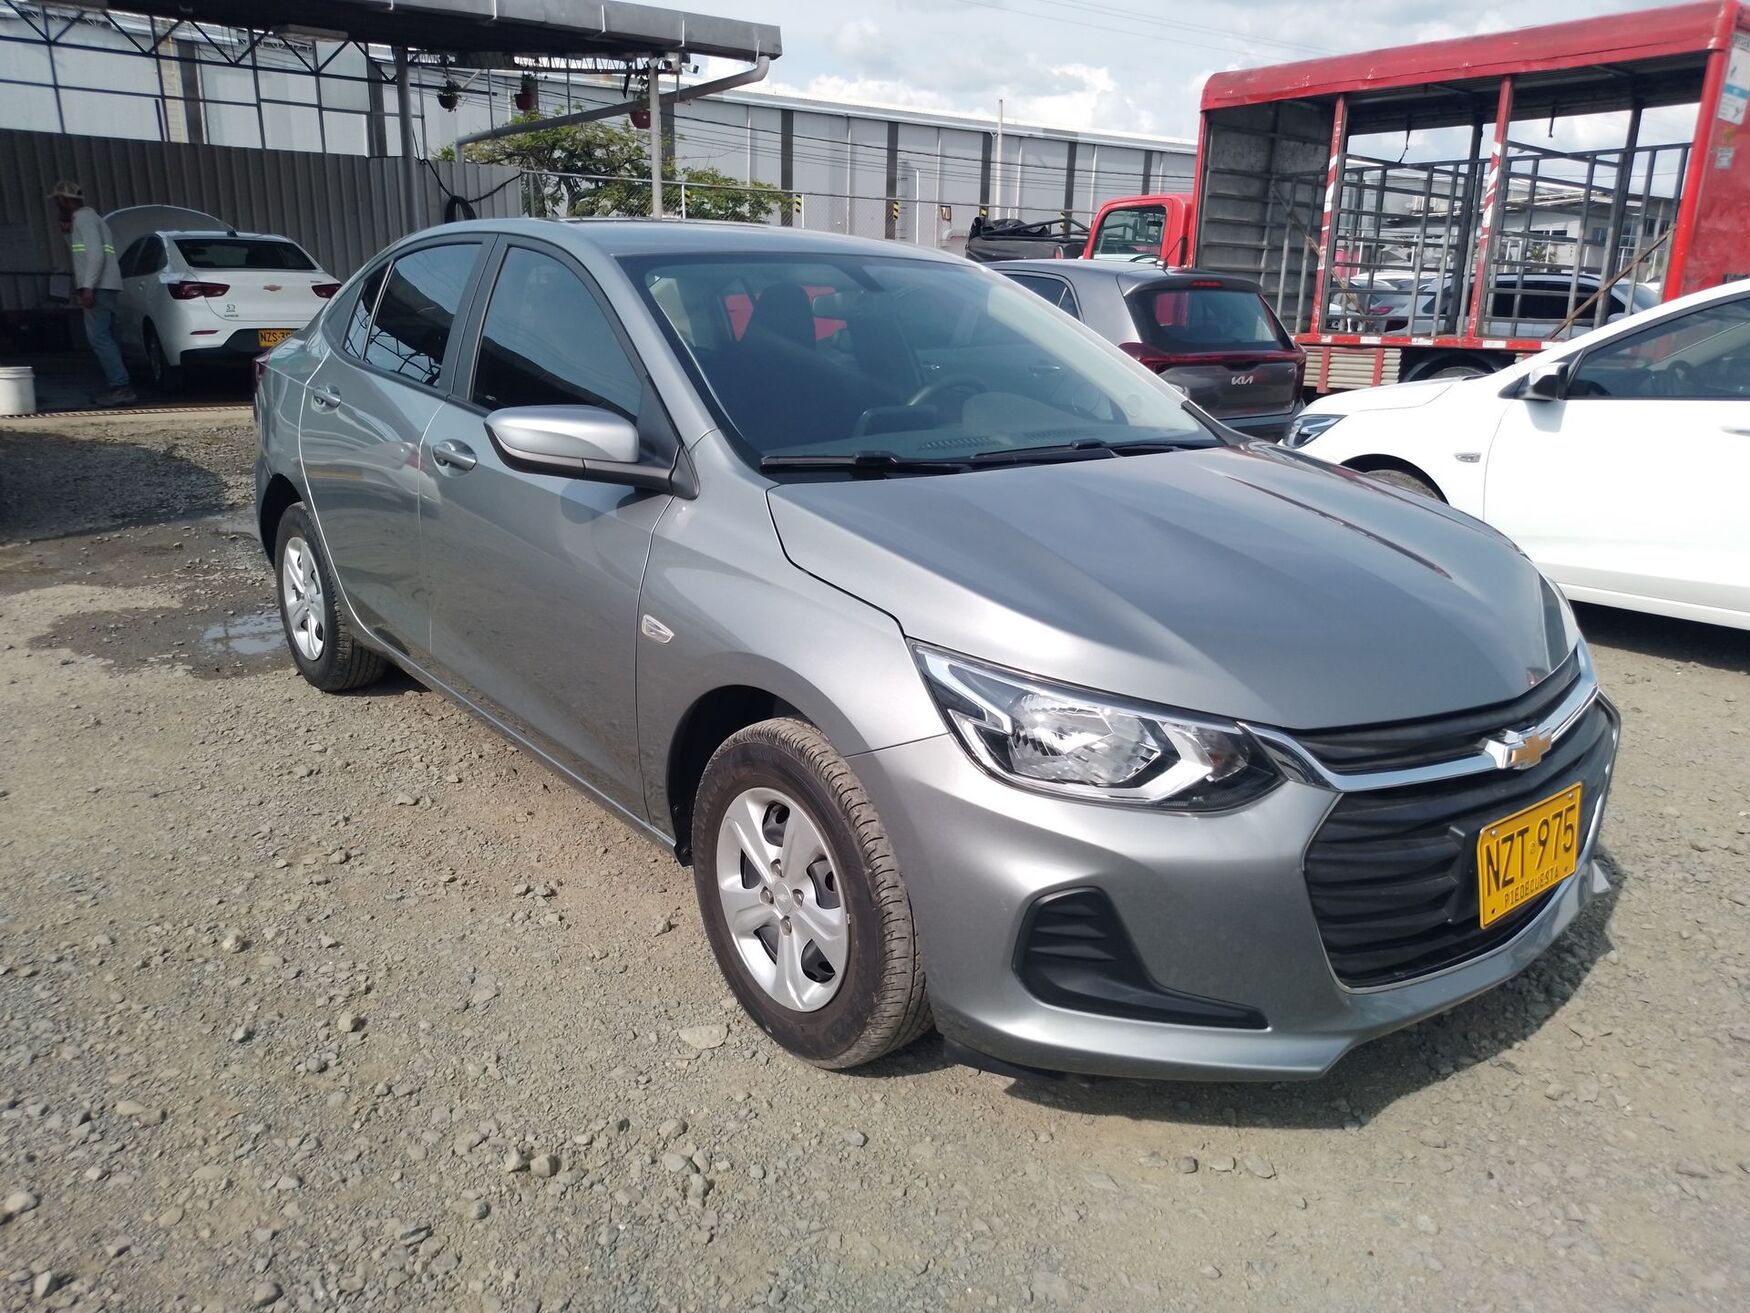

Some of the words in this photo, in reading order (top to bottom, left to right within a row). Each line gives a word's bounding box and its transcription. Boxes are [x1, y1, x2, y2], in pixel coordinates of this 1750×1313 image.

[260, 331, 278, 343] NZS
[1231, 376, 1254, 385] KIA
[1485, 826, 1530, 897] NZT
[1536, 803, 1576, 871] 975
[1504, 866, 1559, 908] PIEDECUESTA
